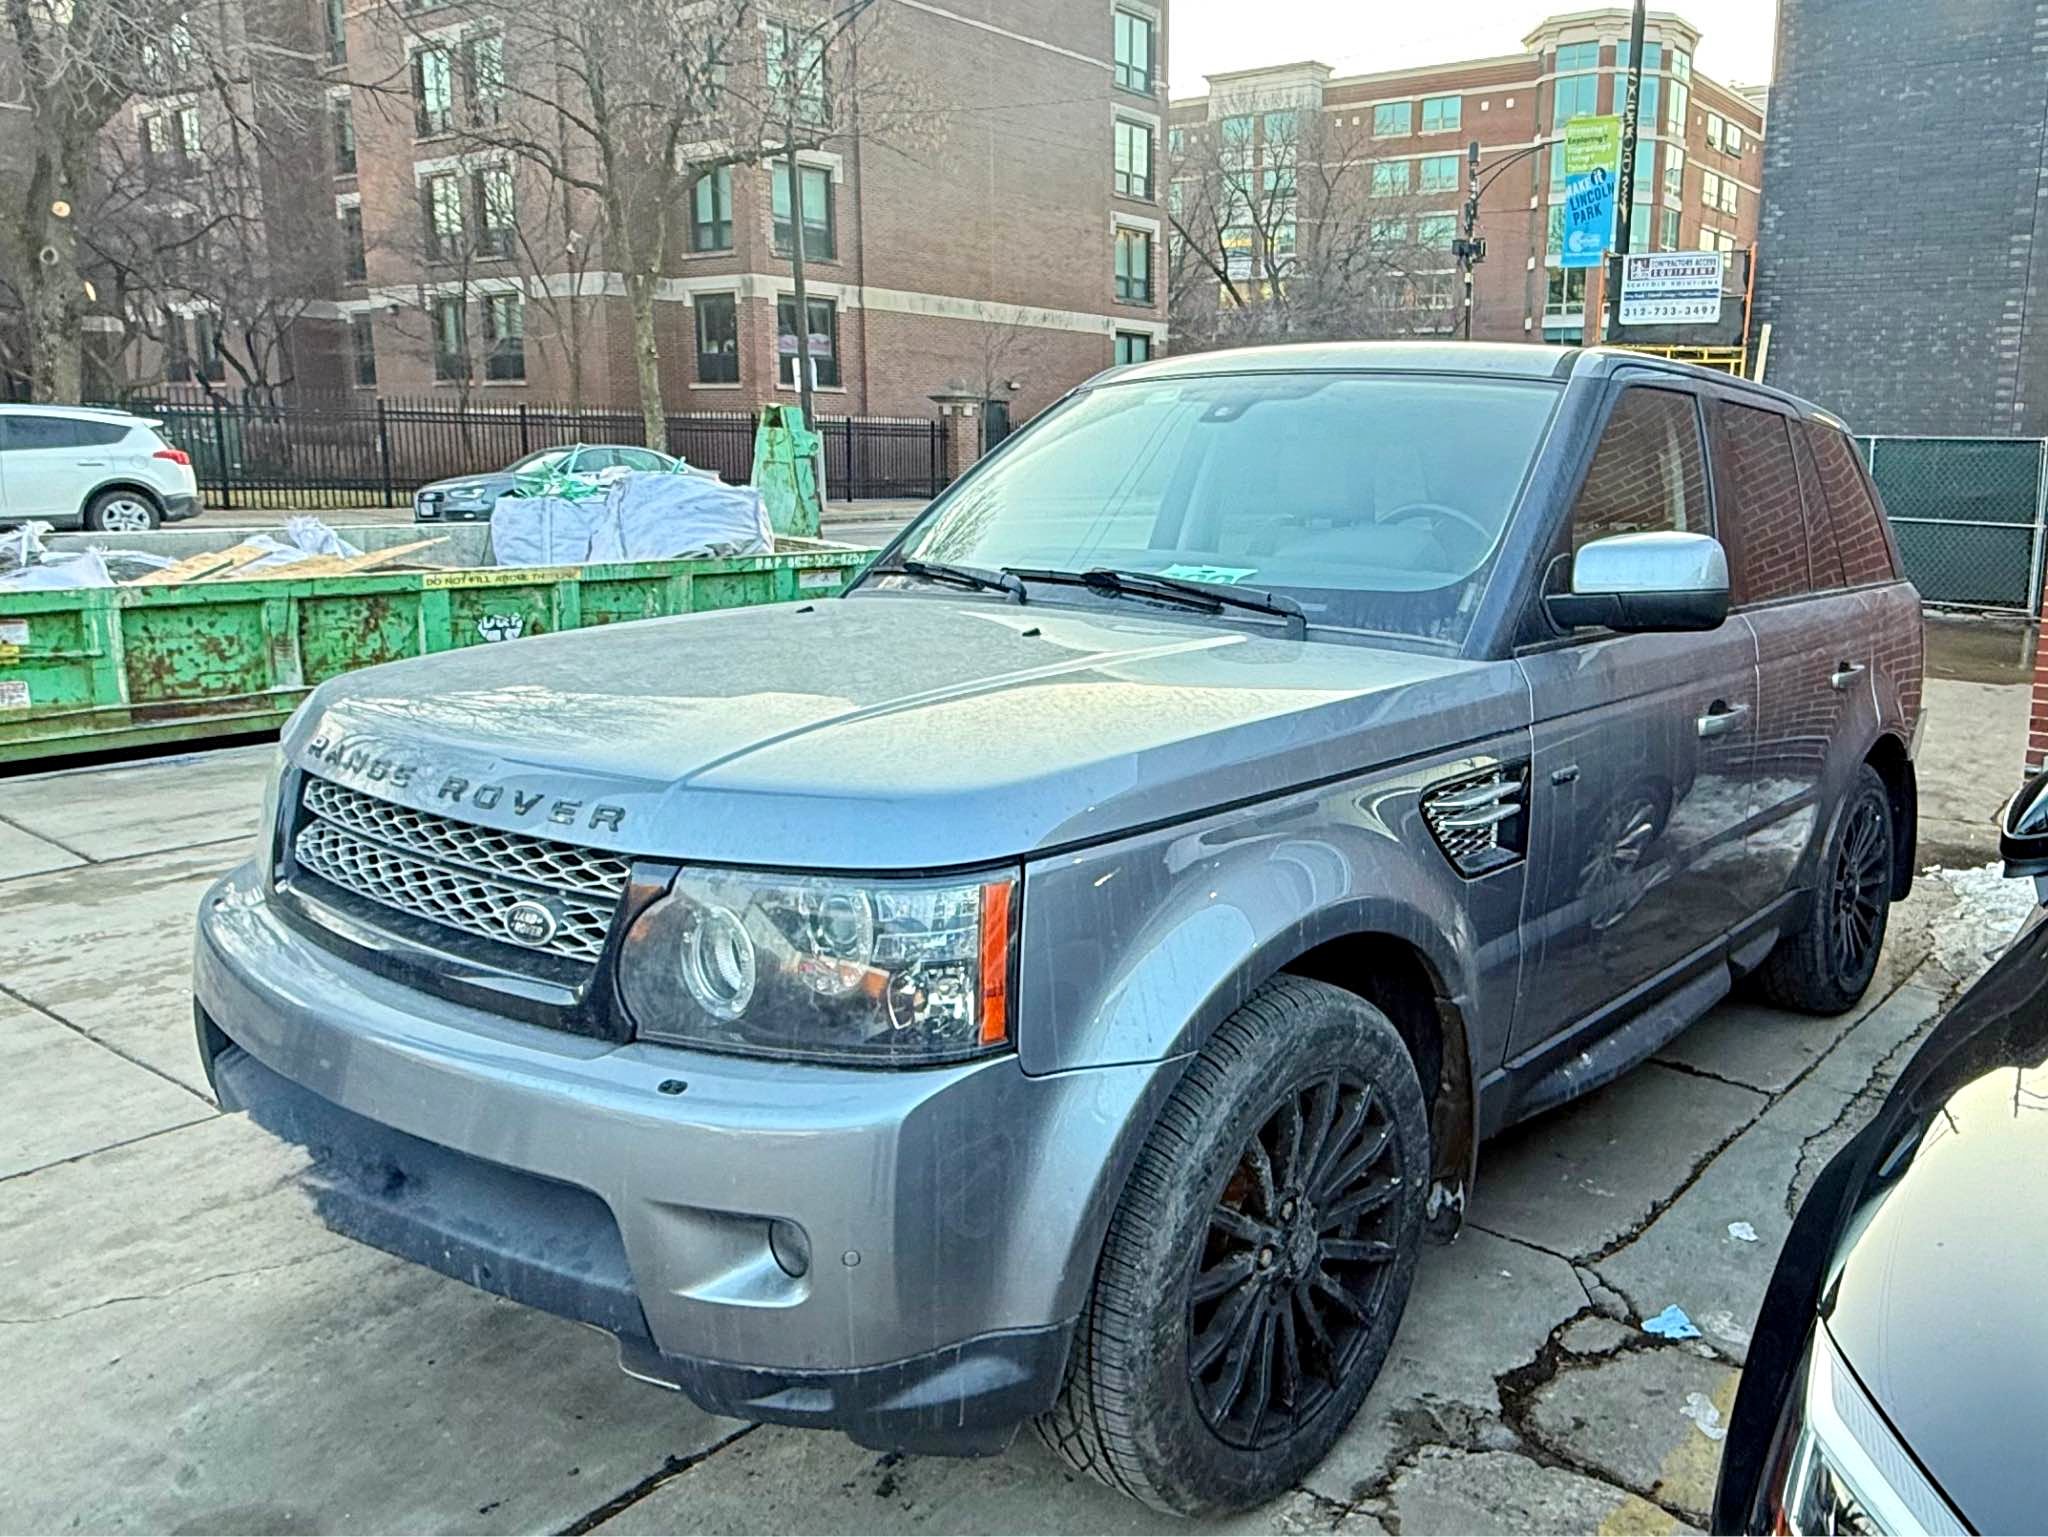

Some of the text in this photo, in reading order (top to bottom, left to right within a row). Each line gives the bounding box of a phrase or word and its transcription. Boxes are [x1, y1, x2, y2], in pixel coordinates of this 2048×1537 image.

[1569, 182, 1614, 211] LINCOLN
[1573, 202, 1603, 225] PARK
[426, 577, 442, 587] DO
[307, 735, 627, 833] RANGE ROVER
